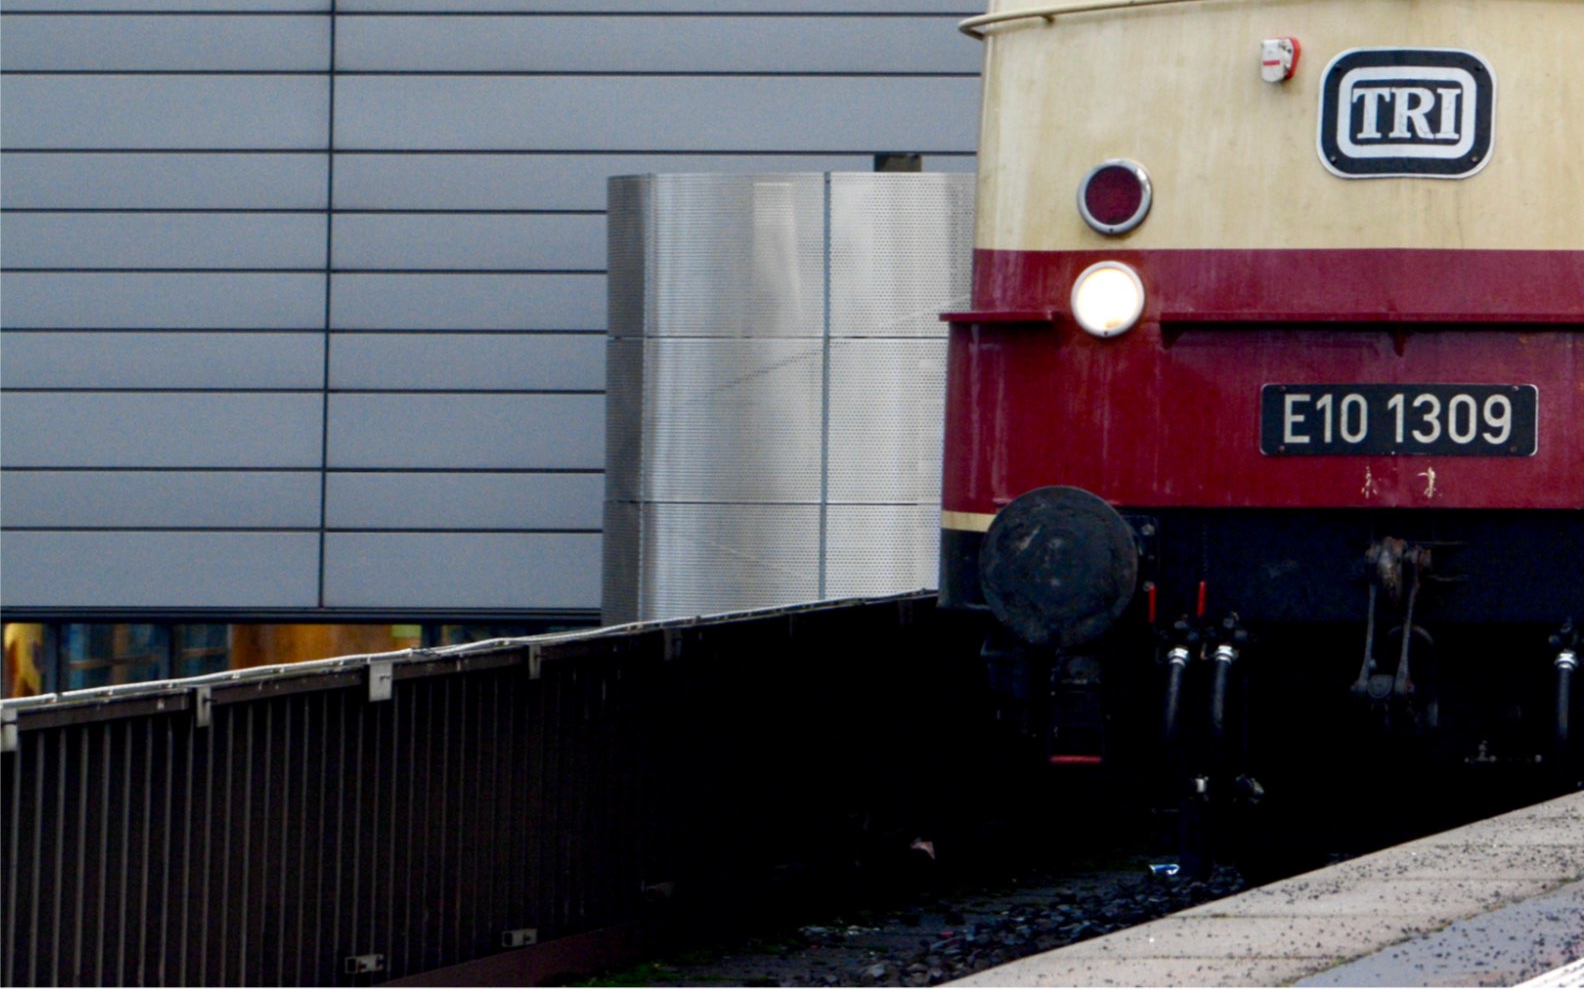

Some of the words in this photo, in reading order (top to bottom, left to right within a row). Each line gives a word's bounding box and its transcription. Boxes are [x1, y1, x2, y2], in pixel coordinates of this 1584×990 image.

[1352, 86, 1462, 140] TRI
[1283, 393, 1369, 444] E10
[1387, 393, 1513, 445] 1309
